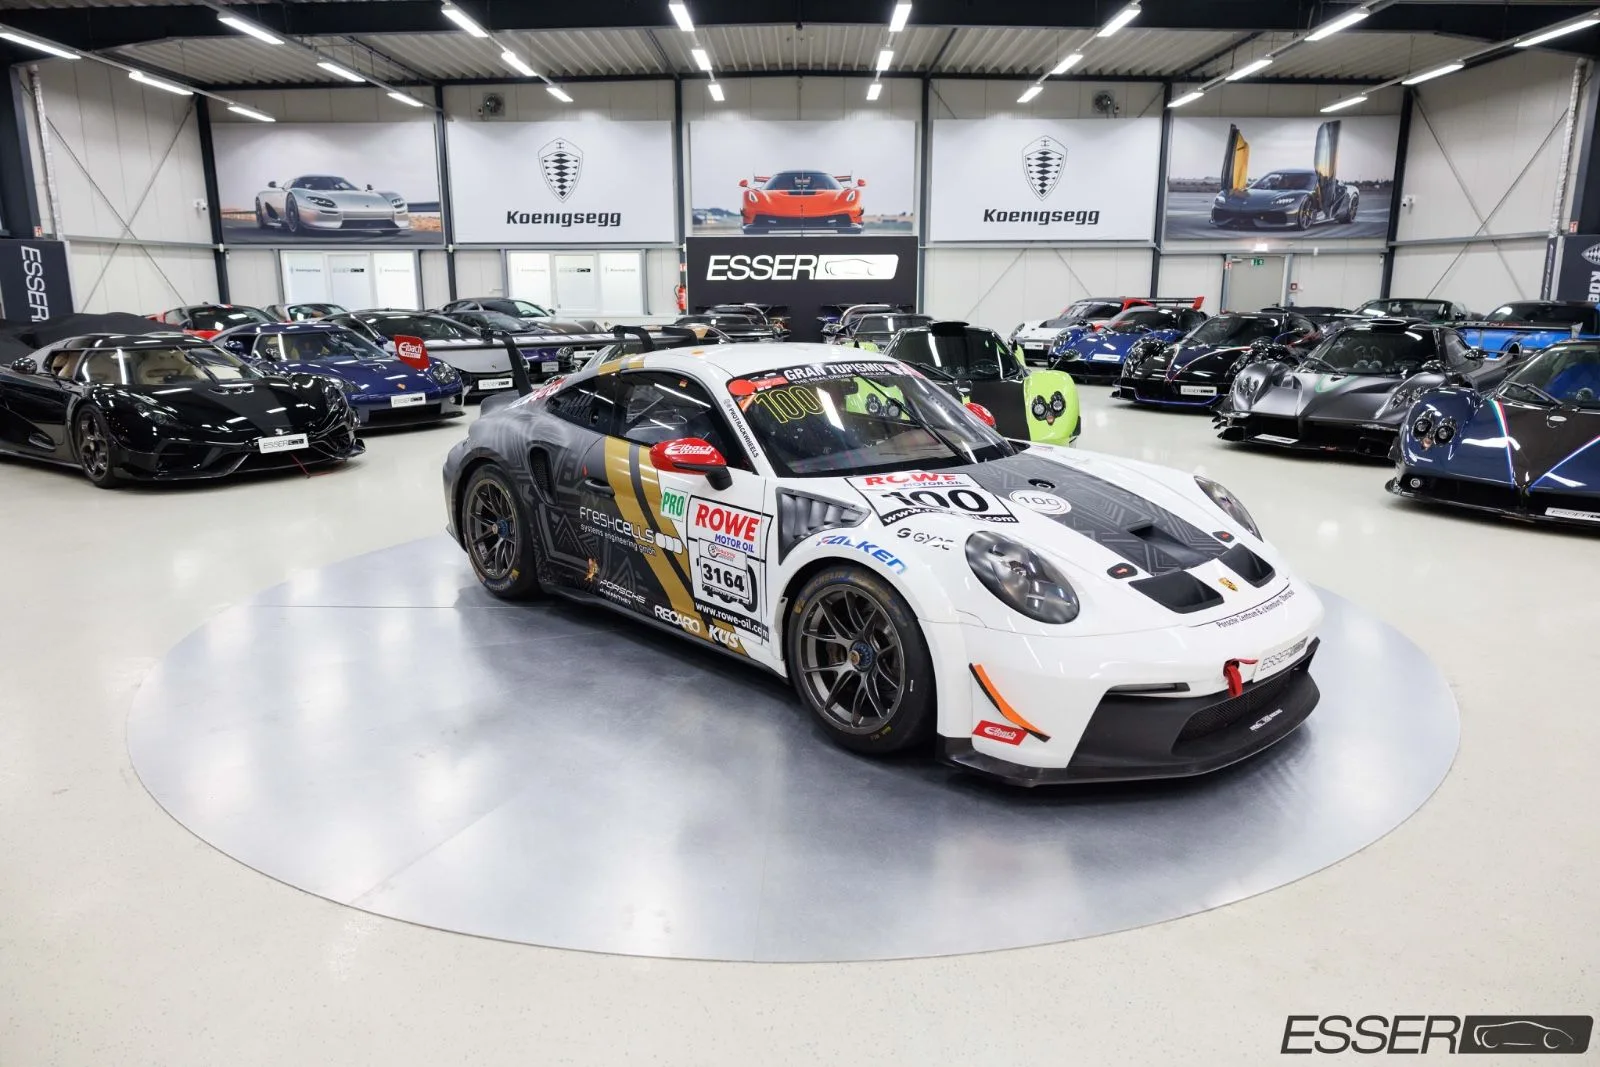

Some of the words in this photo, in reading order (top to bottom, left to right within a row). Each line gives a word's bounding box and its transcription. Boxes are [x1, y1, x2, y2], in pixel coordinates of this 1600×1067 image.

[507, 210, 621, 227] Koenigsegg
[984, 208, 1100, 225] Koenigsegg
[706, 255, 818, 280] ESSER
[21, 246, 50, 320] ESSER
[783, 365, 826, 380] GRAN
[825, 363, 886, 374] TURISMO
[755, 386, 824, 423] 100
[264, 440, 289, 448] ESSER
[729, 408, 759, 458] PROTRACKWHEELS
[665, 442, 714, 455] Eibach
[662, 492, 684, 516] PRO
[881, 489, 989, 513] 100
[695, 504, 760, 542] ROWE
[580, 523, 603, 536] systems
[605, 532, 638, 551] engineering
[715, 534, 741, 549] MOTOR
[743, 543, 754, 553] OIL
[703, 563, 744, 592] 3164
[600, 579, 646, 604] PORSCHE
[654, 605, 700, 633] RECARO
[696, 602, 770, 642] www.rowe-oil.com
